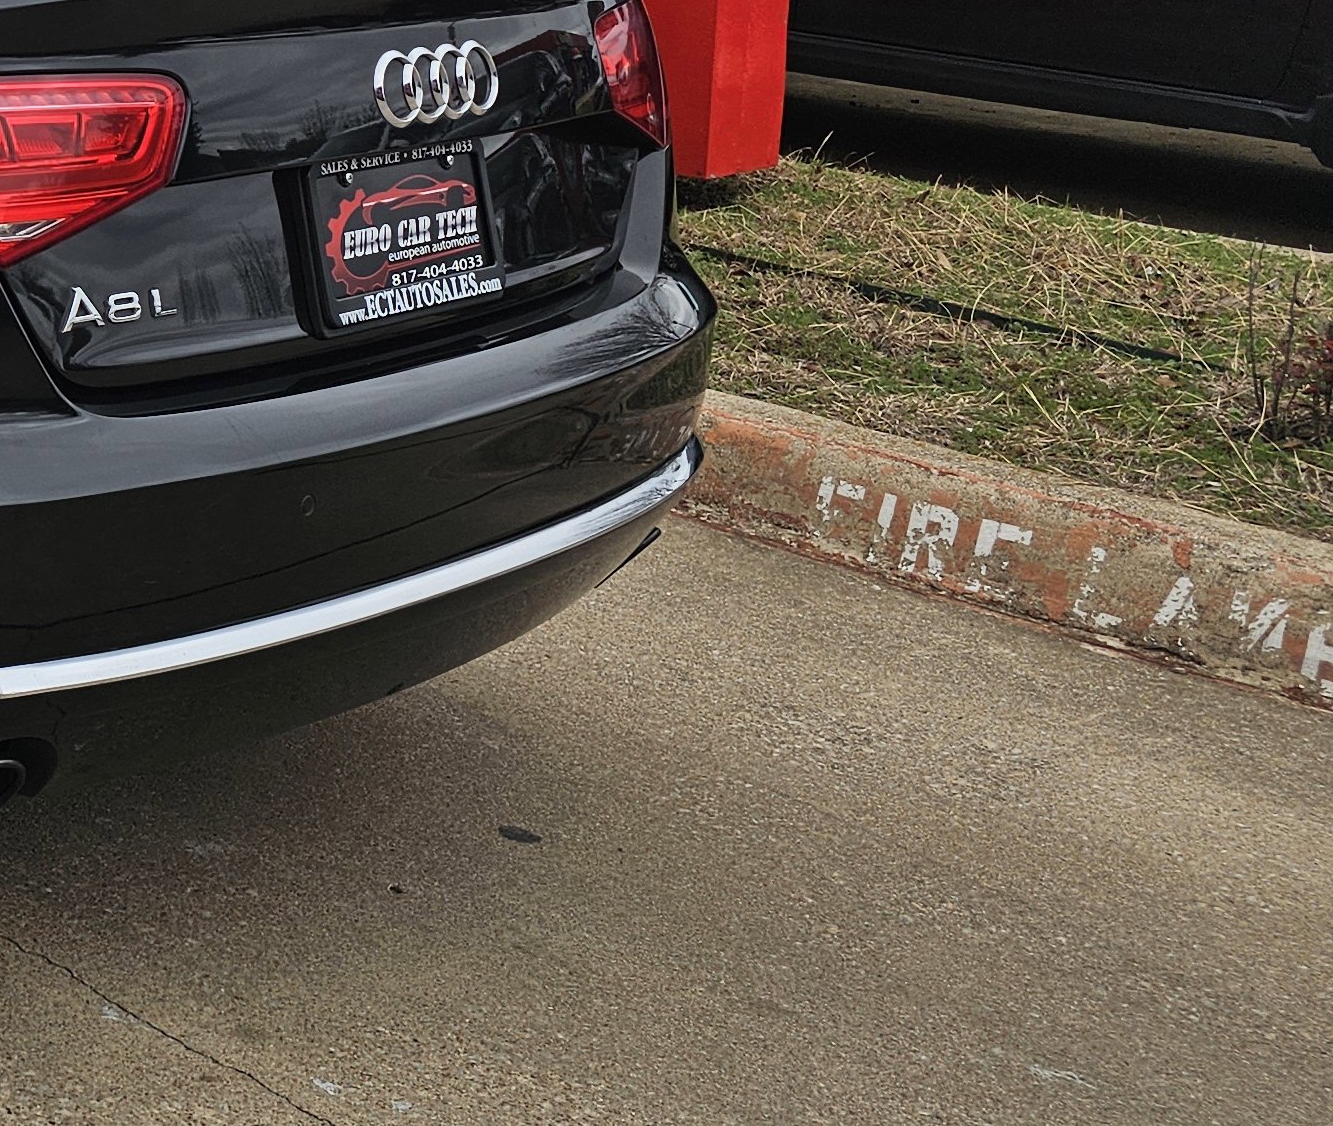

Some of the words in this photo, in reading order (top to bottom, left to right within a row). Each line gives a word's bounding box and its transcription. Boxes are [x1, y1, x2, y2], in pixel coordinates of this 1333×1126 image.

[320, 158, 349, 175] SALES
[350, 158, 359, 170] &
[360, 151, 401, 169] SERVICE
[411, 140, 473, 161] 817-404-4033
[343, 223, 392, 260] EURO
[397, 215, 431, 248] CAR
[435, 206, 478, 240] TECH
[388, 243, 432, 262] european
[431, 233, 480, 253] automotive
[391, 255, 483, 286] 817-404-4033
[339, 272, 503, 326] www.ECTAUTOSALES.com
[814, 475, 1034, 595] FIRE
